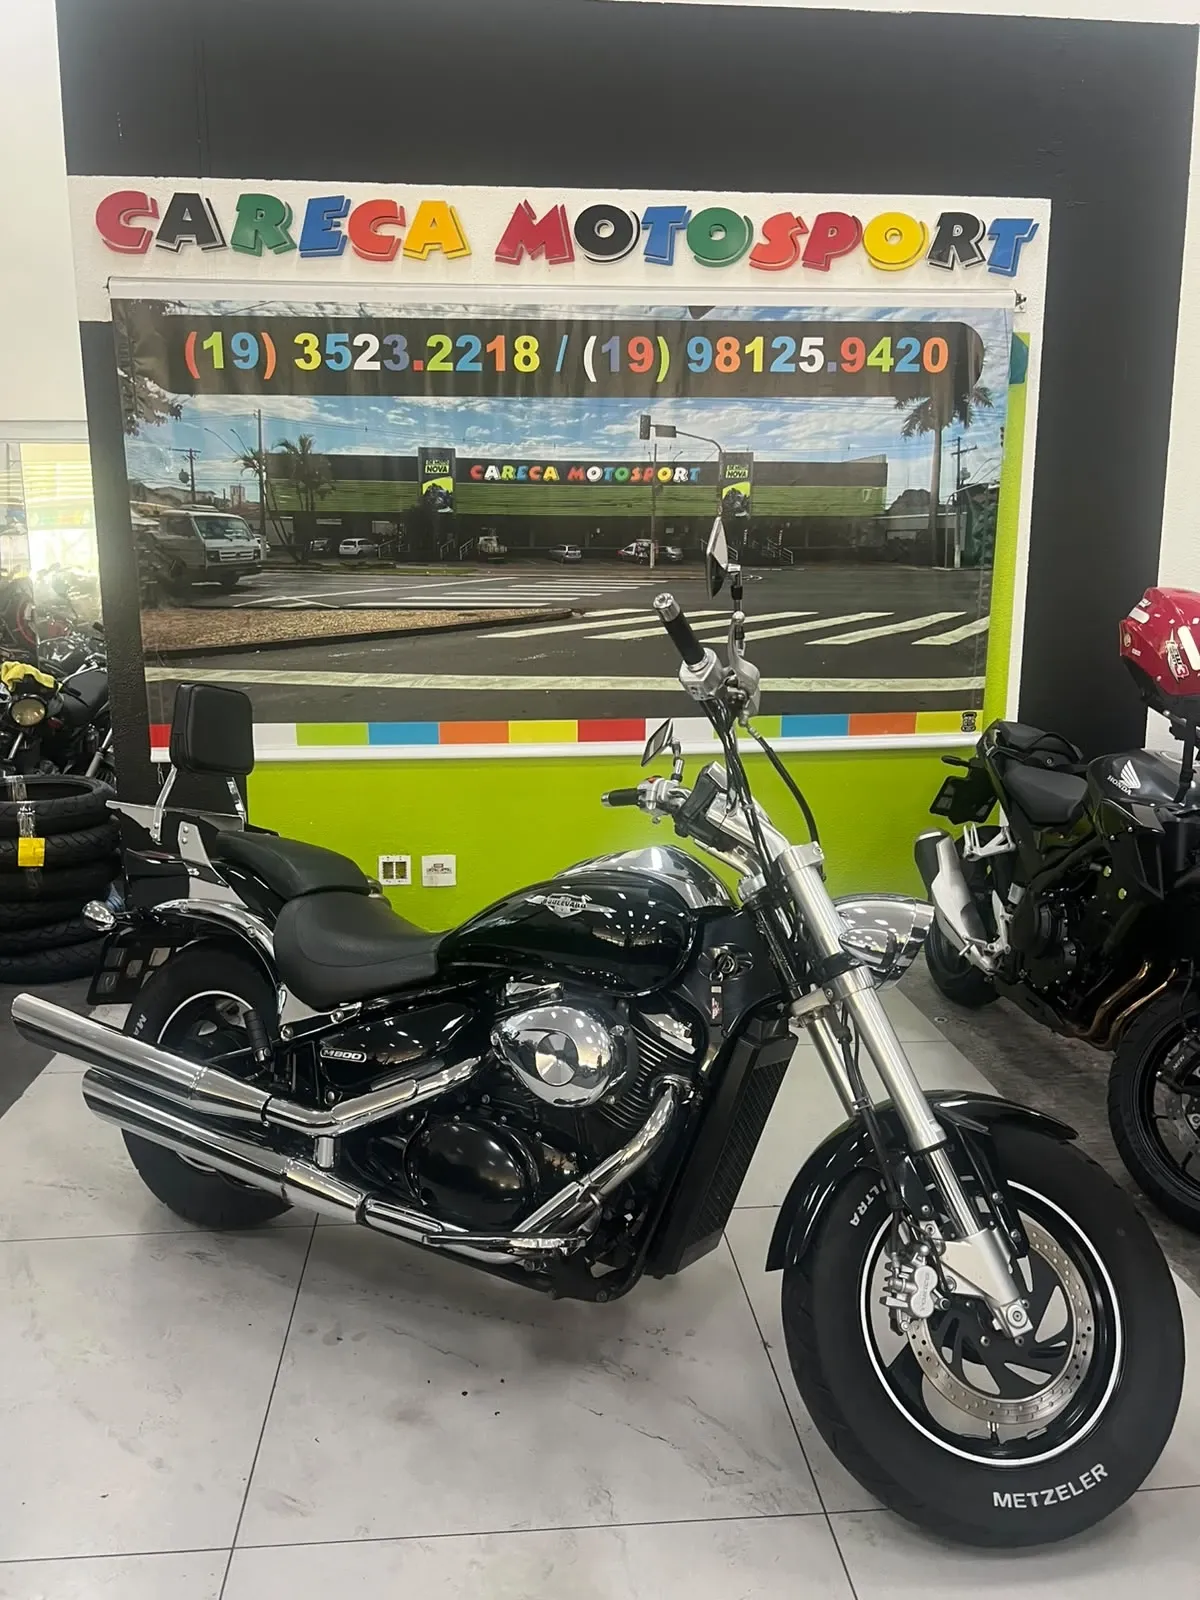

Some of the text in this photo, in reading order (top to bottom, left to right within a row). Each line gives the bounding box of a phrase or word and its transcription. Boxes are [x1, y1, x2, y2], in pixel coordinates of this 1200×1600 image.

[95, 190, 1039, 278] CARECA MOTOSPORT
[184, 331, 277, 380] (19)
[294, 333, 541, 373] 3523.2218
[583, 335, 671, 383] (19)
[686, 336, 949, 373] 98125.9420
[426, 465, 448, 473] NOVA
[470, 464, 700, 484] CARECA MOTOSPORT
[1106, 774, 1132, 796] HONDA
[323, 1049, 362, 1060] M800
[992, 1463, 1109, 1509] METZELER
